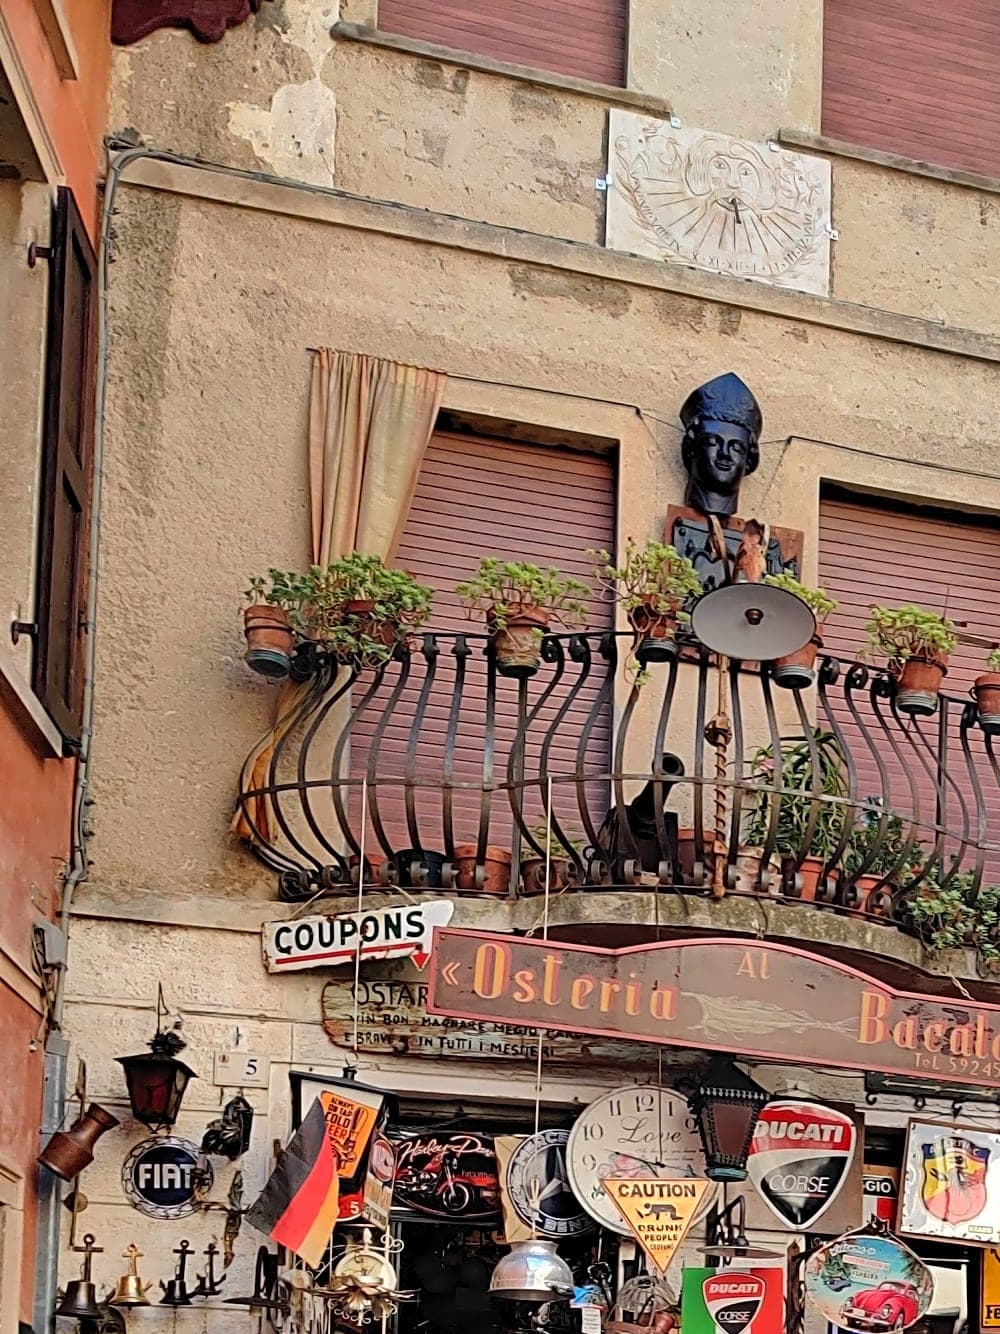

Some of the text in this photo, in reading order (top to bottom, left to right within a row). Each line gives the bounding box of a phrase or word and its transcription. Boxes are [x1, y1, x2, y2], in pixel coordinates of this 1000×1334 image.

[274, 909, 426, 953] COUPONS
[736, 951, 770, 981] Al
[473, 942, 680, 1021] Osteria
[382, 1013, 410, 1026] BON
[245, 1058, 258, 1076] 5
[609, 1099, 622, 1117] 11
[635, 1095, 655, 1112] 12
[325, 1111, 351, 1129] COLD
[326, 1122, 348, 1141] EER
[583, 1123, 604, 1141] 10
[616, 1115, 682, 1144] Love
[754, 1119, 844, 1144] DUCATI
[582, 1153, 597, 1171] 9
[138, 1162, 195, 1190] FIAT
[767, 1173, 831, 1195] CORSE
[617, 1183, 697, 1199] CAUTION
[637, 1223, 685, 1233] DRUNK
[644, 1233, 679, 1242] PEOPLE
[709, 1282, 760, 1295] DUCATI
[718, 1310, 751, 1321] CORSE
